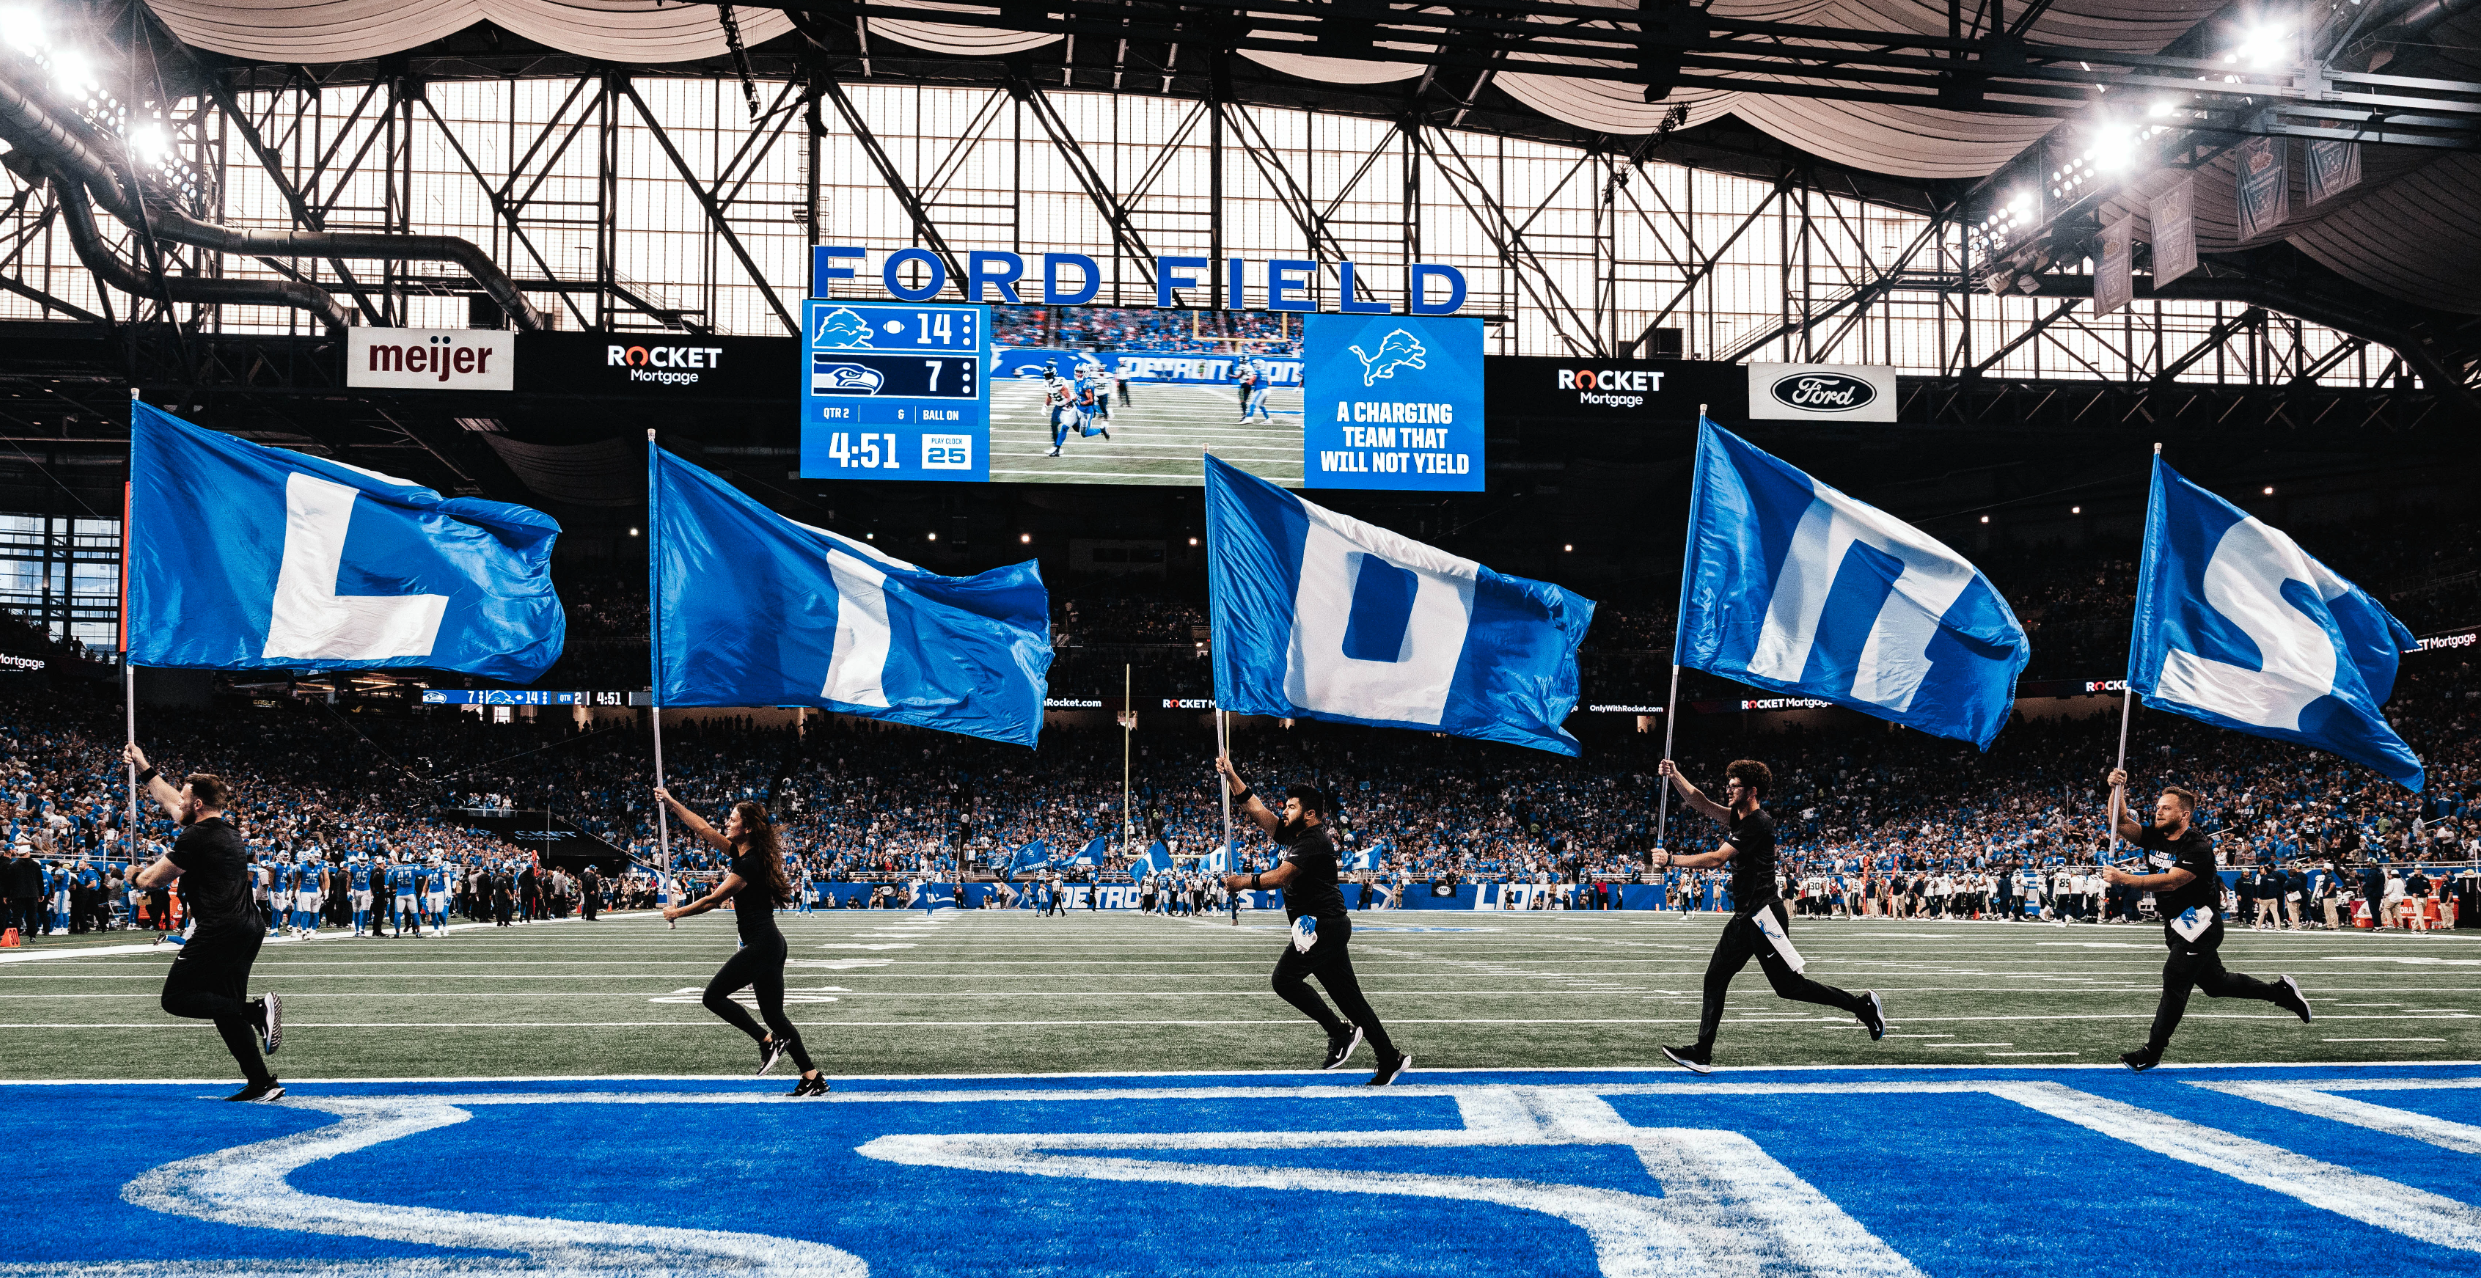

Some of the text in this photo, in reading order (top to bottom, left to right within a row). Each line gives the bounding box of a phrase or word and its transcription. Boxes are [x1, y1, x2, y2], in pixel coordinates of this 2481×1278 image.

[811, 244, 1467, 316] FORD FIELD
[917, 313, 952, 345] 14
[369, 335, 493, 382] meijer
[607, 344, 723, 369] ROCKET
[630, 368, 699, 386] Mortgage
[925, 360, 943, 392] 7
[1558, 368, 1665, 392] ROCKET
[1580, 391, 1644, 408] Mortgage
[1792, 377, 1856, 405] Ford
[823, 407, 850, 420] QTR 2
[922, 410, 960, 421] BALL ON
[1336, 401, 1453, 425] A CHARGING
[1342, 426, 1449, 450] TEAM THAT
[828, 432, 900, 469] 4:51
[927, 447, 966, 464] 25
[1320, 450, 1470, 475] WILL NOT YIELD
[262, 471, 449, 661] L
[820, 549, 892, 708] I
[2154, 515, 2350, 735] S
[2430, 633, 2477, 649] Mortgage
[2085, 679, 2128, 692] ROCKE
[467, 690, 474, 704] 7
[525, 690, 538, 704] 14
[559, 691, 582, 704] QTR 2
[596, 691, 622, 705] 4:51
[1162, 698, 1208, 709] ROCKET
[1741, 698, 1785, 710] ROCKET
[1589, 704, 1664, 714] OnlyWithRocket.com
